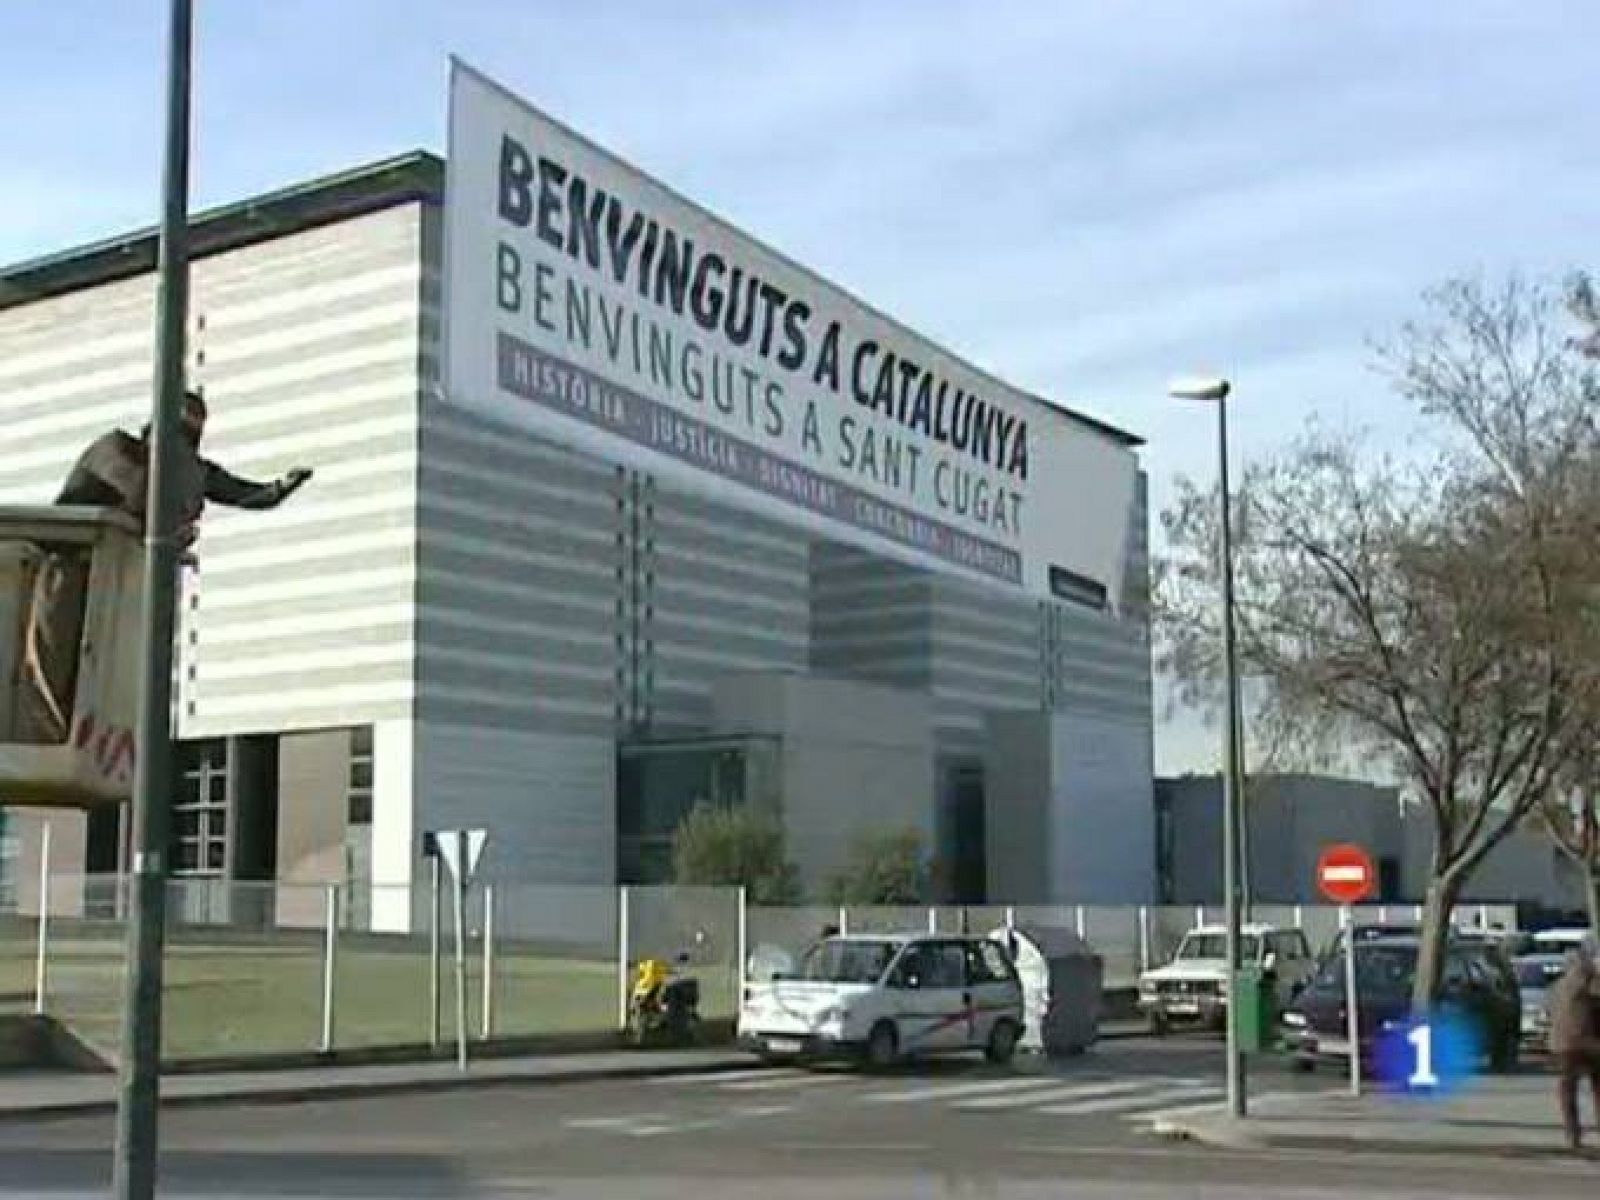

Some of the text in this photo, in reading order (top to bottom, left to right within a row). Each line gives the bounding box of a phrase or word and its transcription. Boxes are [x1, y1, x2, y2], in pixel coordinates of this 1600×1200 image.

[498, 241, 784, 437] BENVINGUTS
[802, 400, 823, 454] A
[839, 416, 921, 493] SANT
[933, 459, 1024, 538] CUGAT
[499, 133, 1027, 480] BENVINGUTS A CATALUNYA
